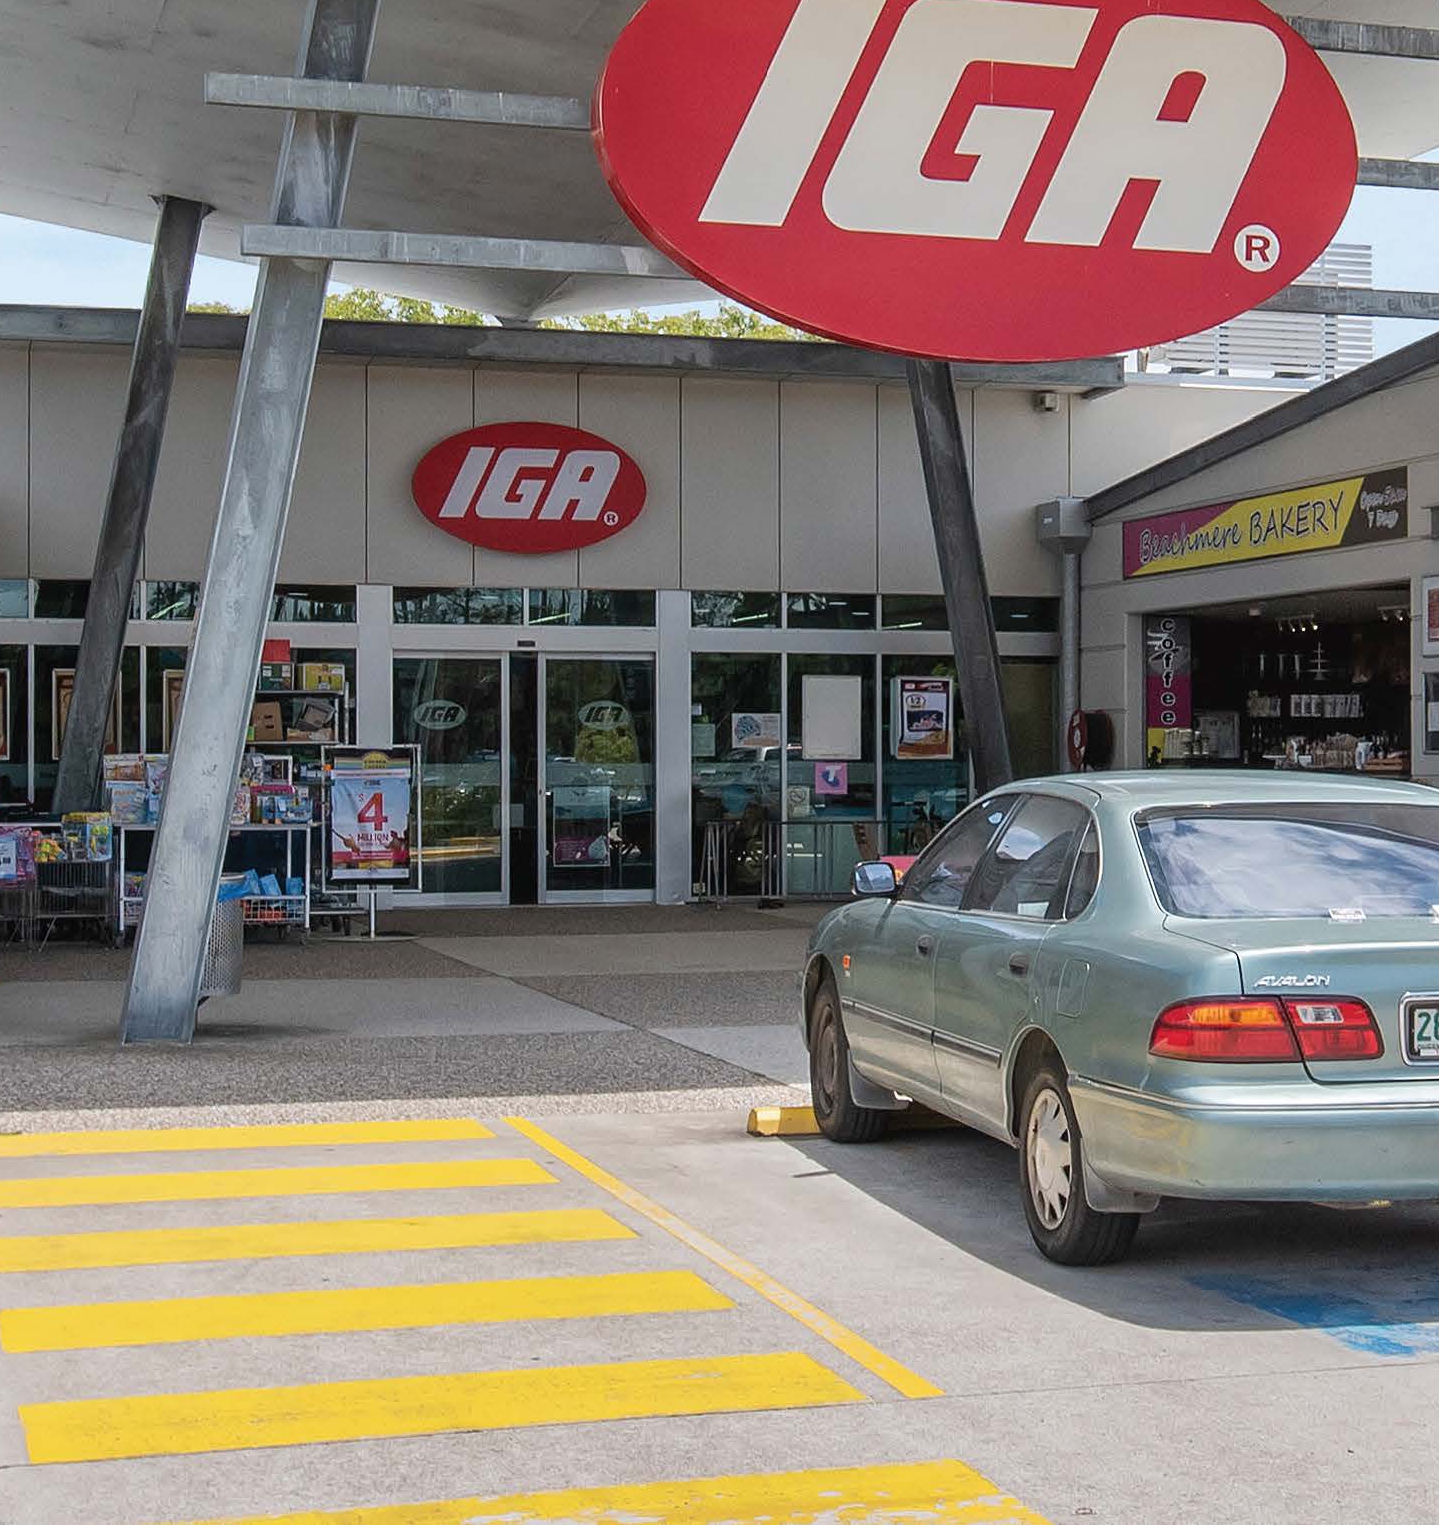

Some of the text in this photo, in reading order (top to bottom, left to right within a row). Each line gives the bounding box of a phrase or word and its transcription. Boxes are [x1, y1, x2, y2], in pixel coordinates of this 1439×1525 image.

[438, 446, 621, 521] IGA
[1139, 490, 1344, 564] Beachmere BAKERY
[420, 705, 460, 723] IGA
[585, 705, 623, 724] IGA
[357, 833, 389, 843] MILLION
[1254, 974, 1331, 987] AVALON
